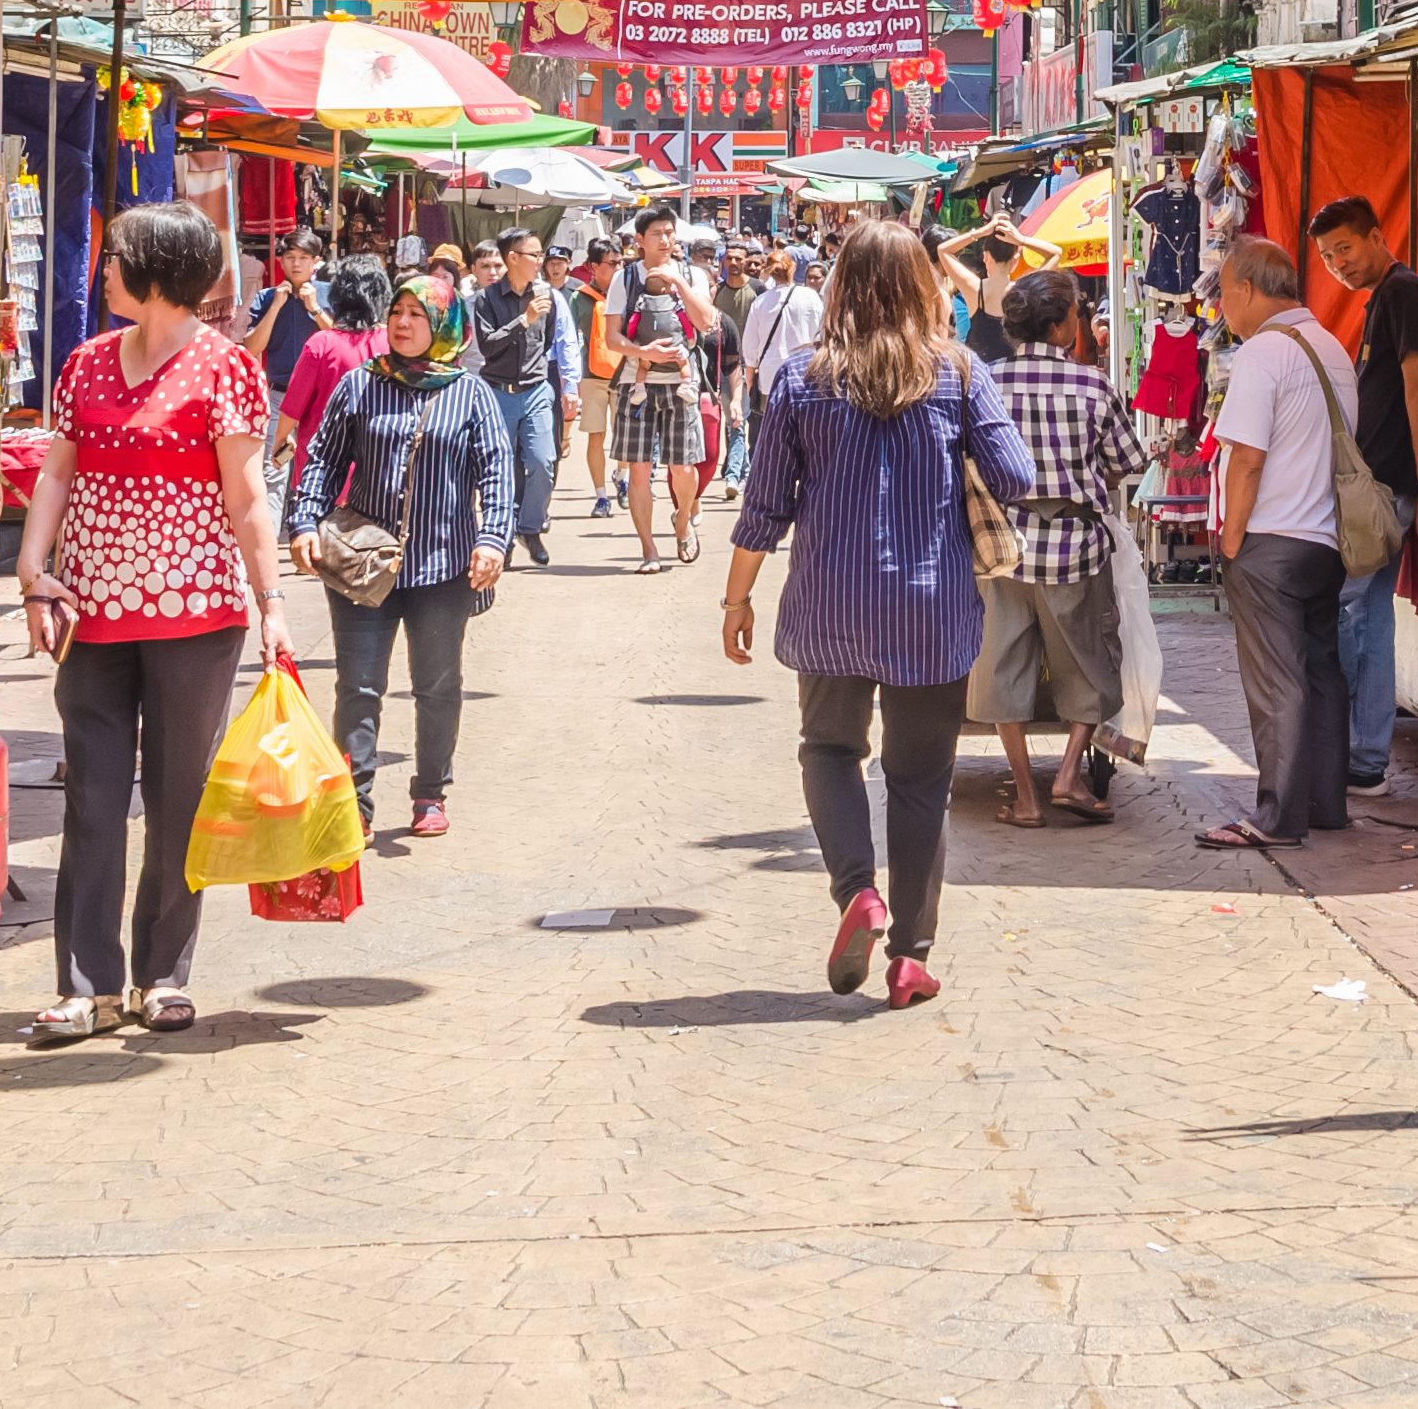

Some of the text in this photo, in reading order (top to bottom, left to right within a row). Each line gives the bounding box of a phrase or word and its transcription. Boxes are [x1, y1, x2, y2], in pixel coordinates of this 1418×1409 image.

[376, 10, 490, 35] CHINAOWN
[628, 1, 665, 18] FOR
[672, 3, 792, 22] PRE-ORDERS,
[800, 0, 865, 19] PLEASE
[625, 16, 921, 45] 03 2072 8888 (TEL) 012 886 8321 (HP)
[439, 36, 490, 56] NTRE
[804, 41, 894, 57] www.fungwong.my
[634, 132, 728, 172] KK
